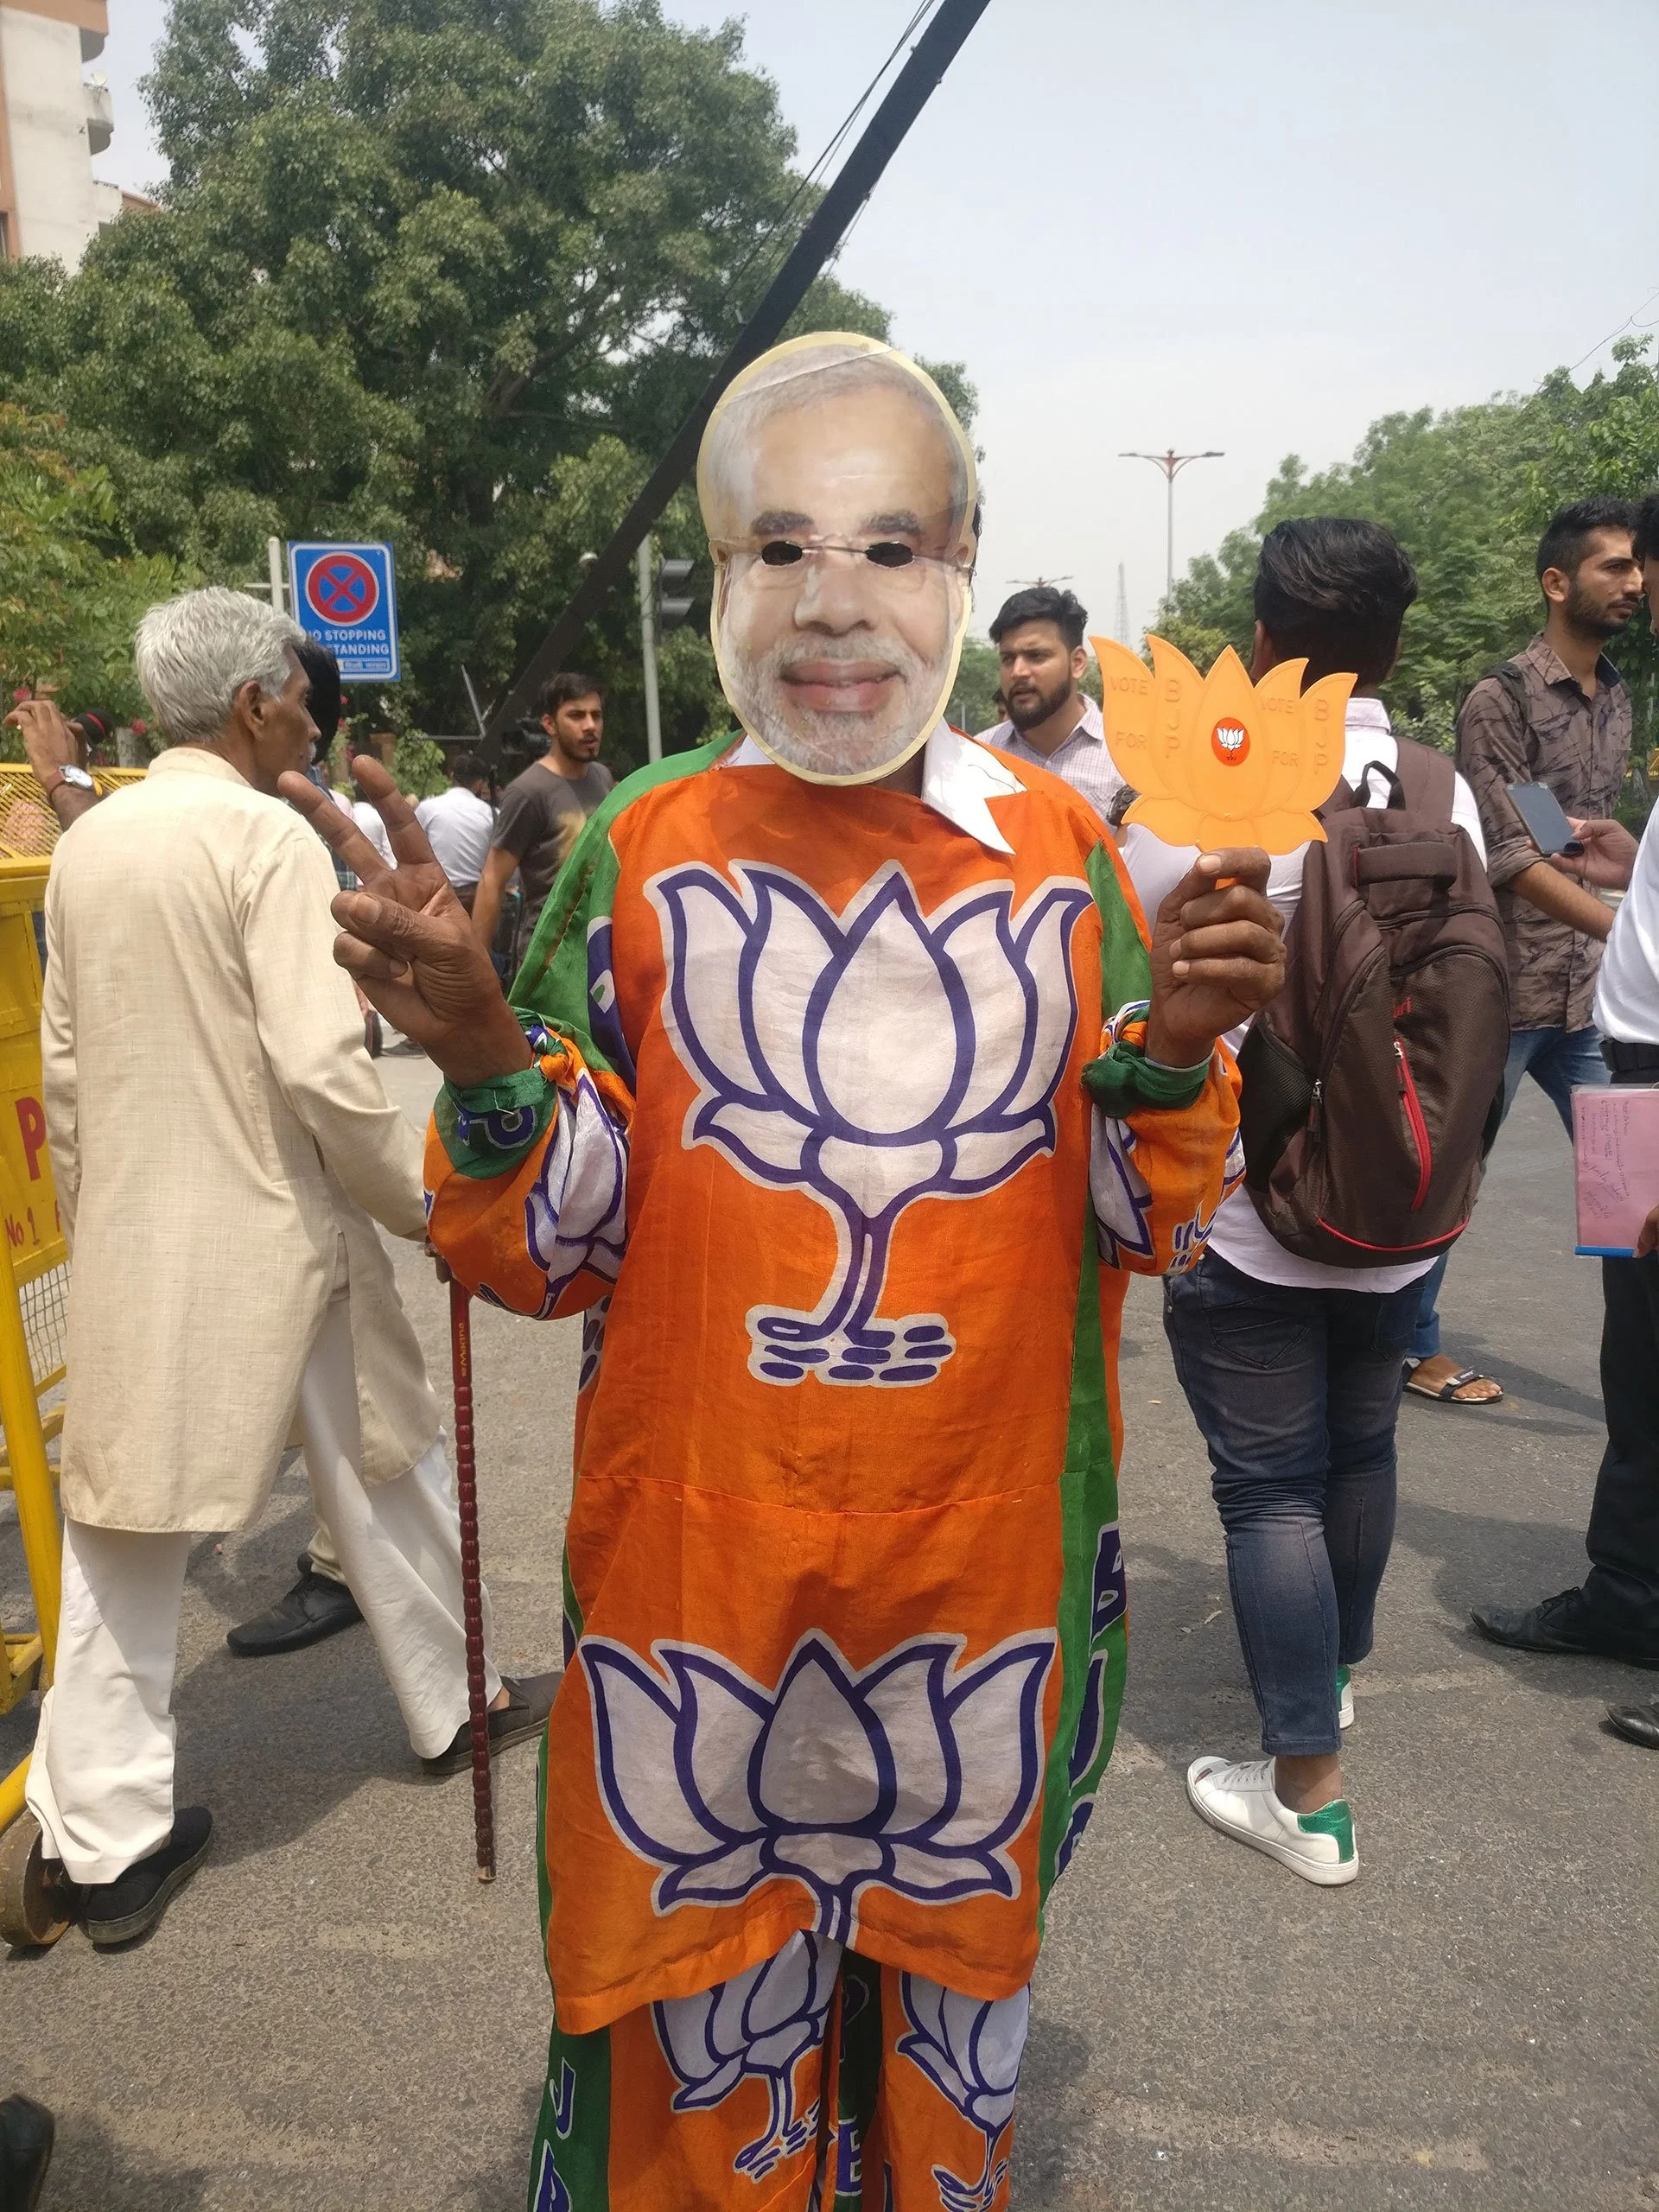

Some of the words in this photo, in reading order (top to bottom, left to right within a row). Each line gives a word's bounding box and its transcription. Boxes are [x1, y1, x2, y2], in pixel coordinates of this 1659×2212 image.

[324, 629, 386, 641] STOPPING
[328, 644, 390, 655] TANDING
[1109, 677, 1148, 696] VOTE
[1260, 695, 1295, 715] VOTE
[1116, 731, 1147, 749] FOR
[1271, 749, 1300, 767] FOR
